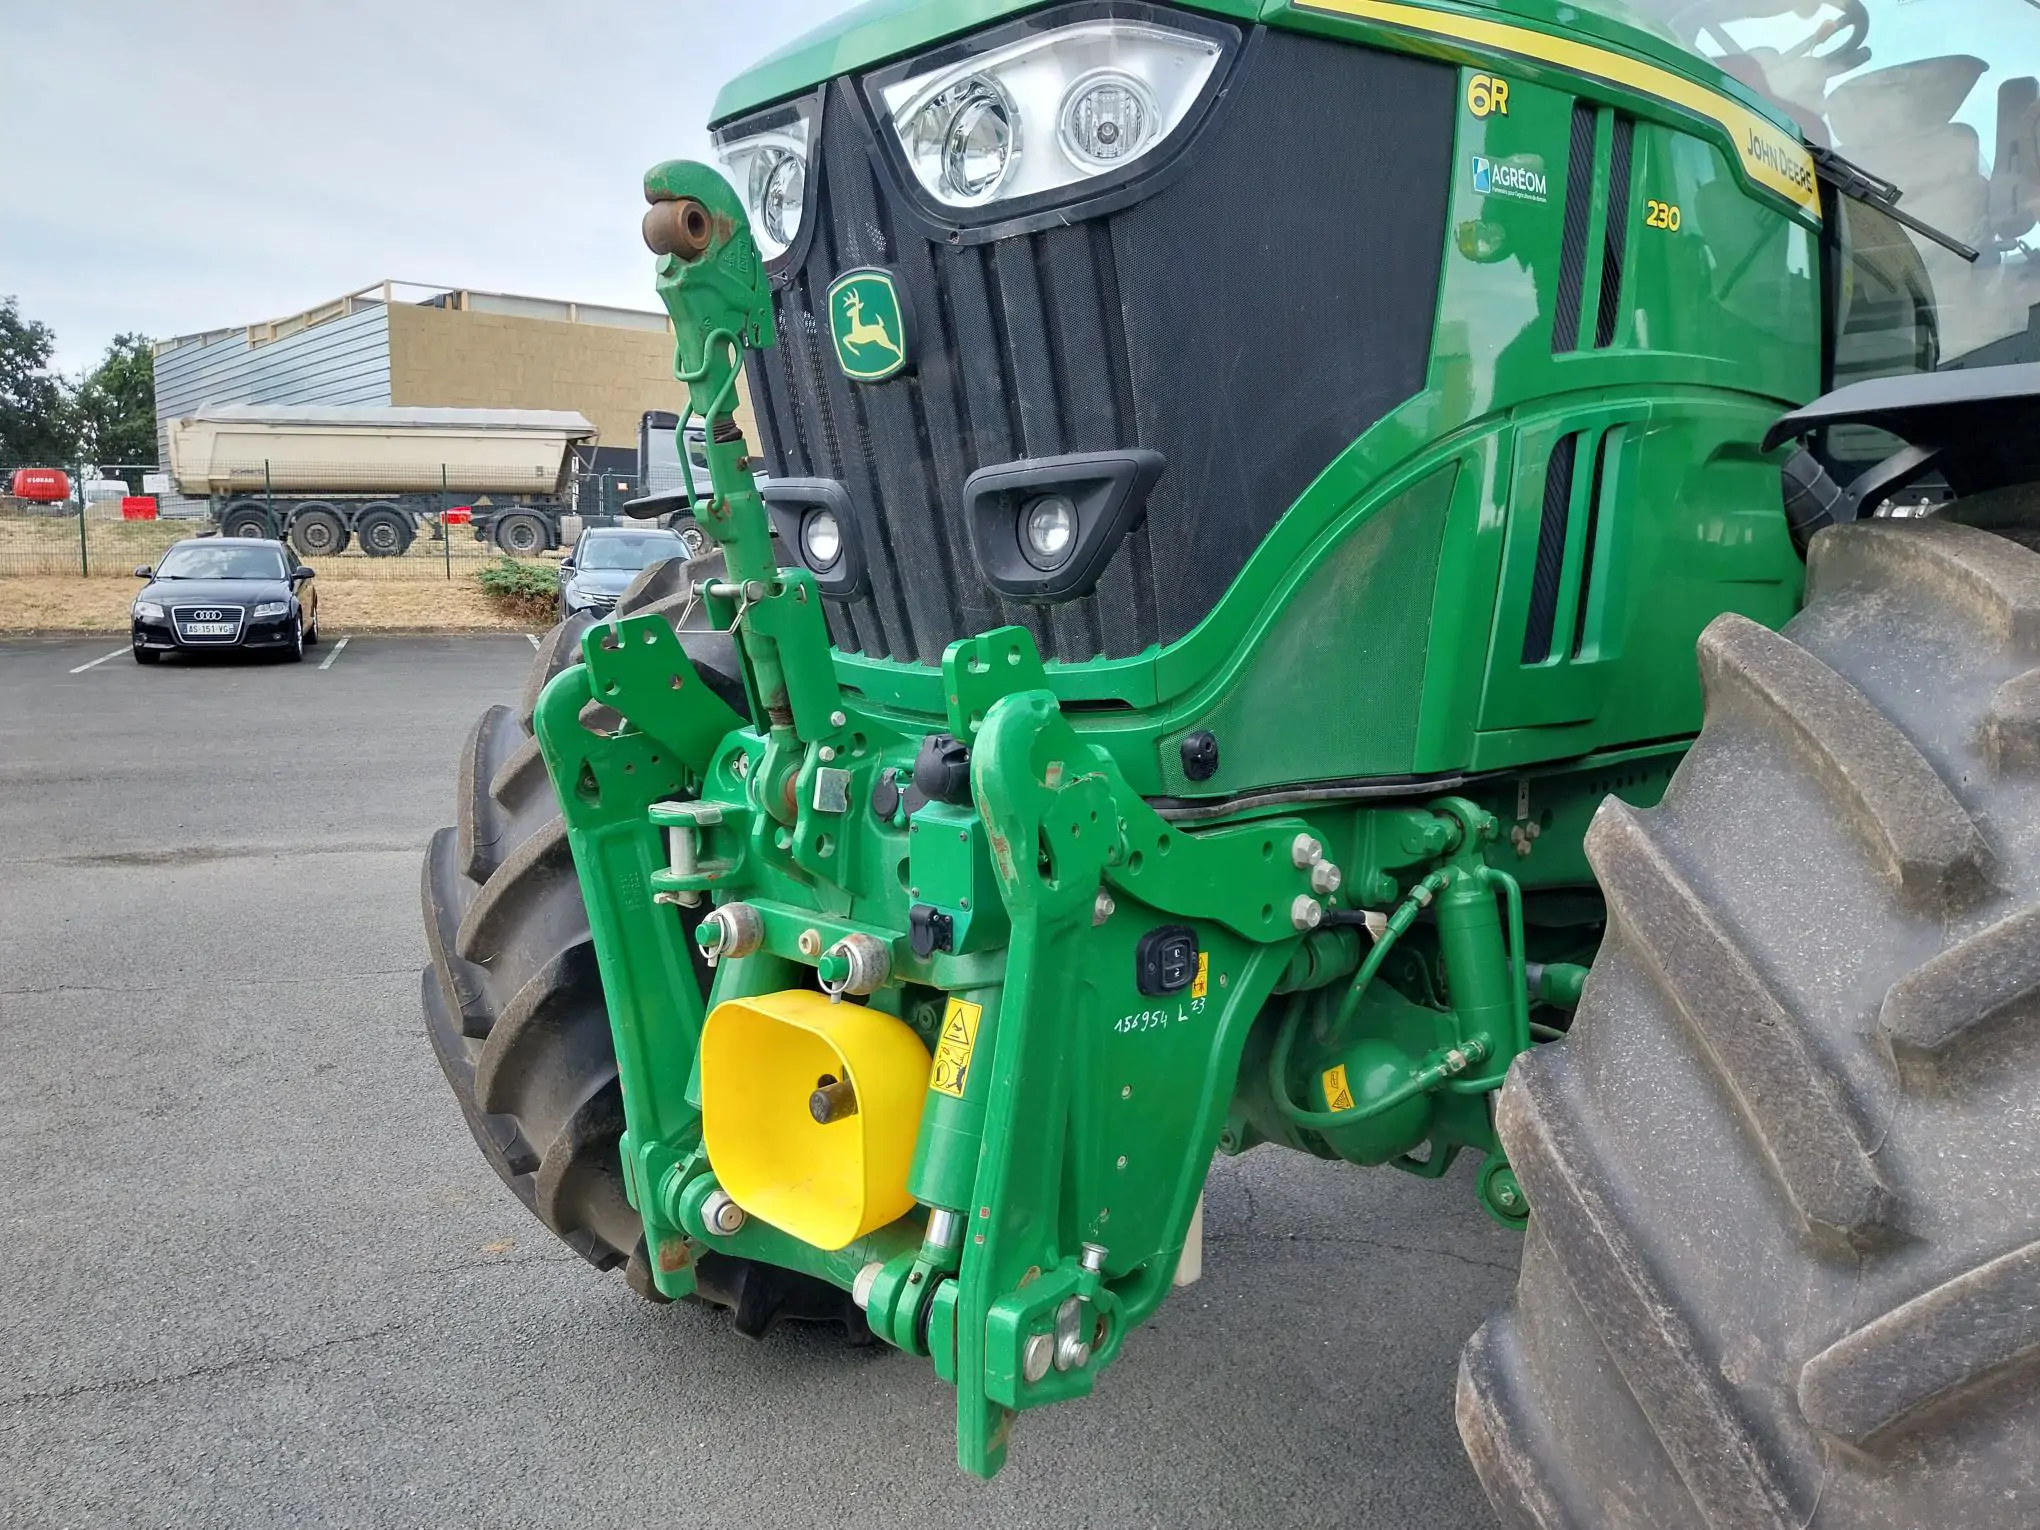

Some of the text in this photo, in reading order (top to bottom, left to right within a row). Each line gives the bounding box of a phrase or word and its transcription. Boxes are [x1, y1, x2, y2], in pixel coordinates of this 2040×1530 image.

[1467, 73, 1509, 117] 6R
[1747, 127, 1813, 194] JOHN DEERE
[1492, 163, 1547, 195] AGRÉOM
[1646, 199, 1681, 232] 230
[1114, 1010, 1168, 1032] 156954
[1178, 1003, 1189, 1022] L
